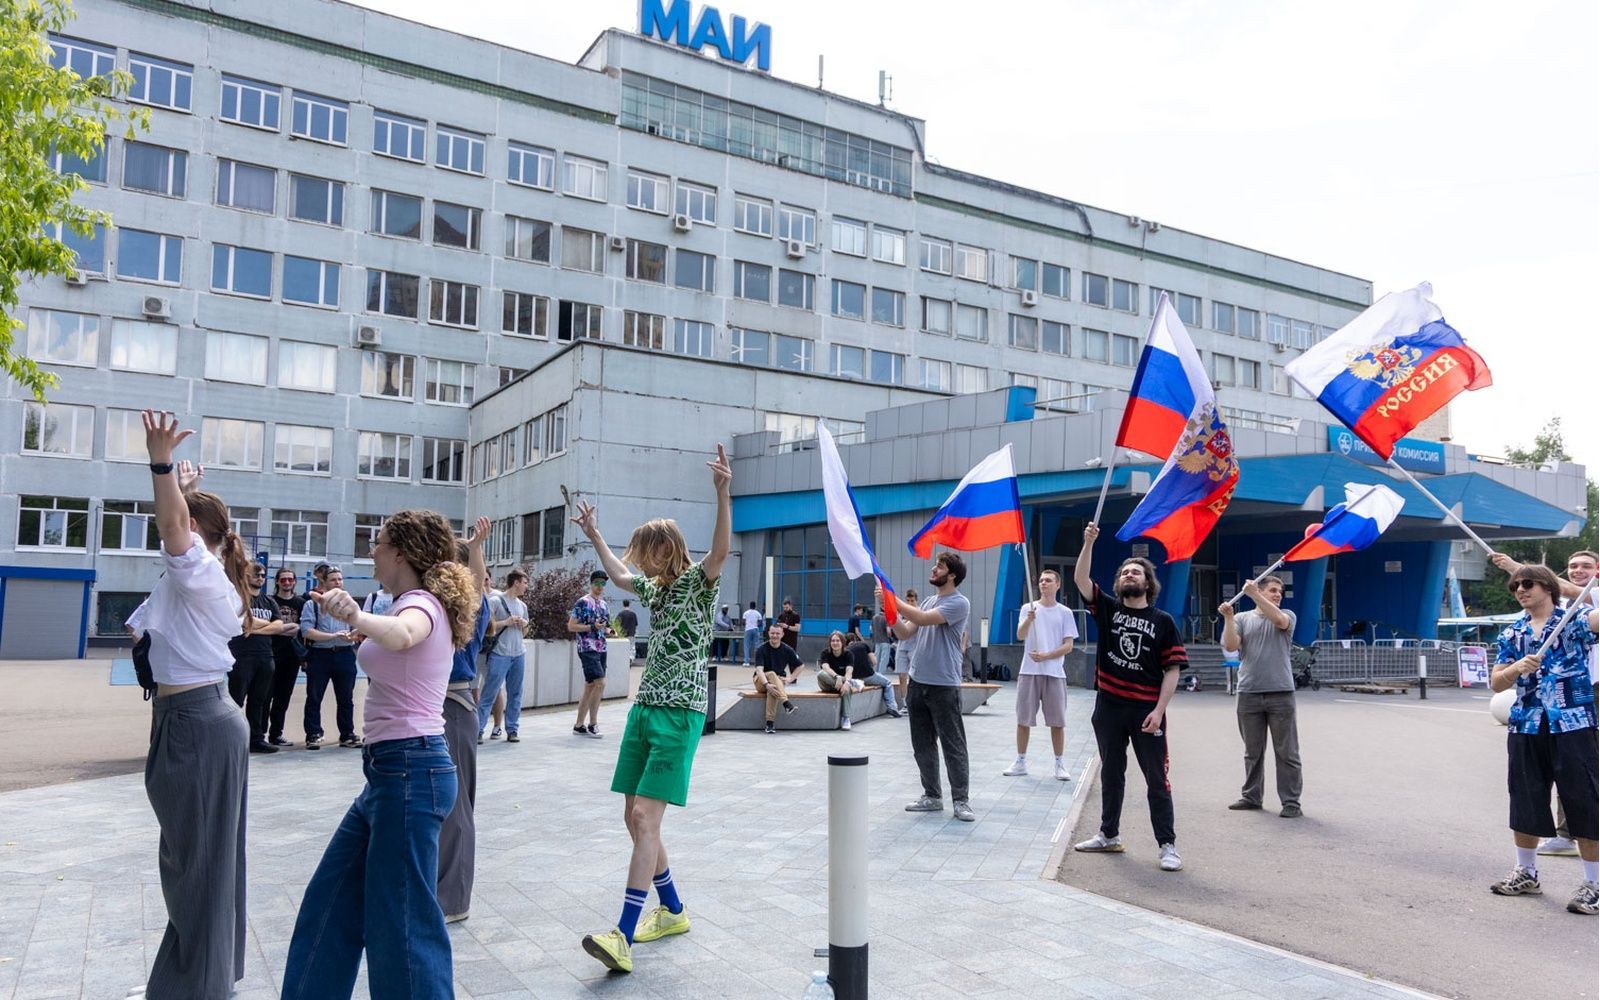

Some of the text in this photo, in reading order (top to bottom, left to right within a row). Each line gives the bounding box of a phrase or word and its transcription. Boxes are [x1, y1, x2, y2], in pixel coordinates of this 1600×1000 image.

[639, 0, 772, 71] МАИ
[1376, 353, 1459, 418] РОССИЯ
[1398, 446, 1440, 462] КОМИССИЯ
